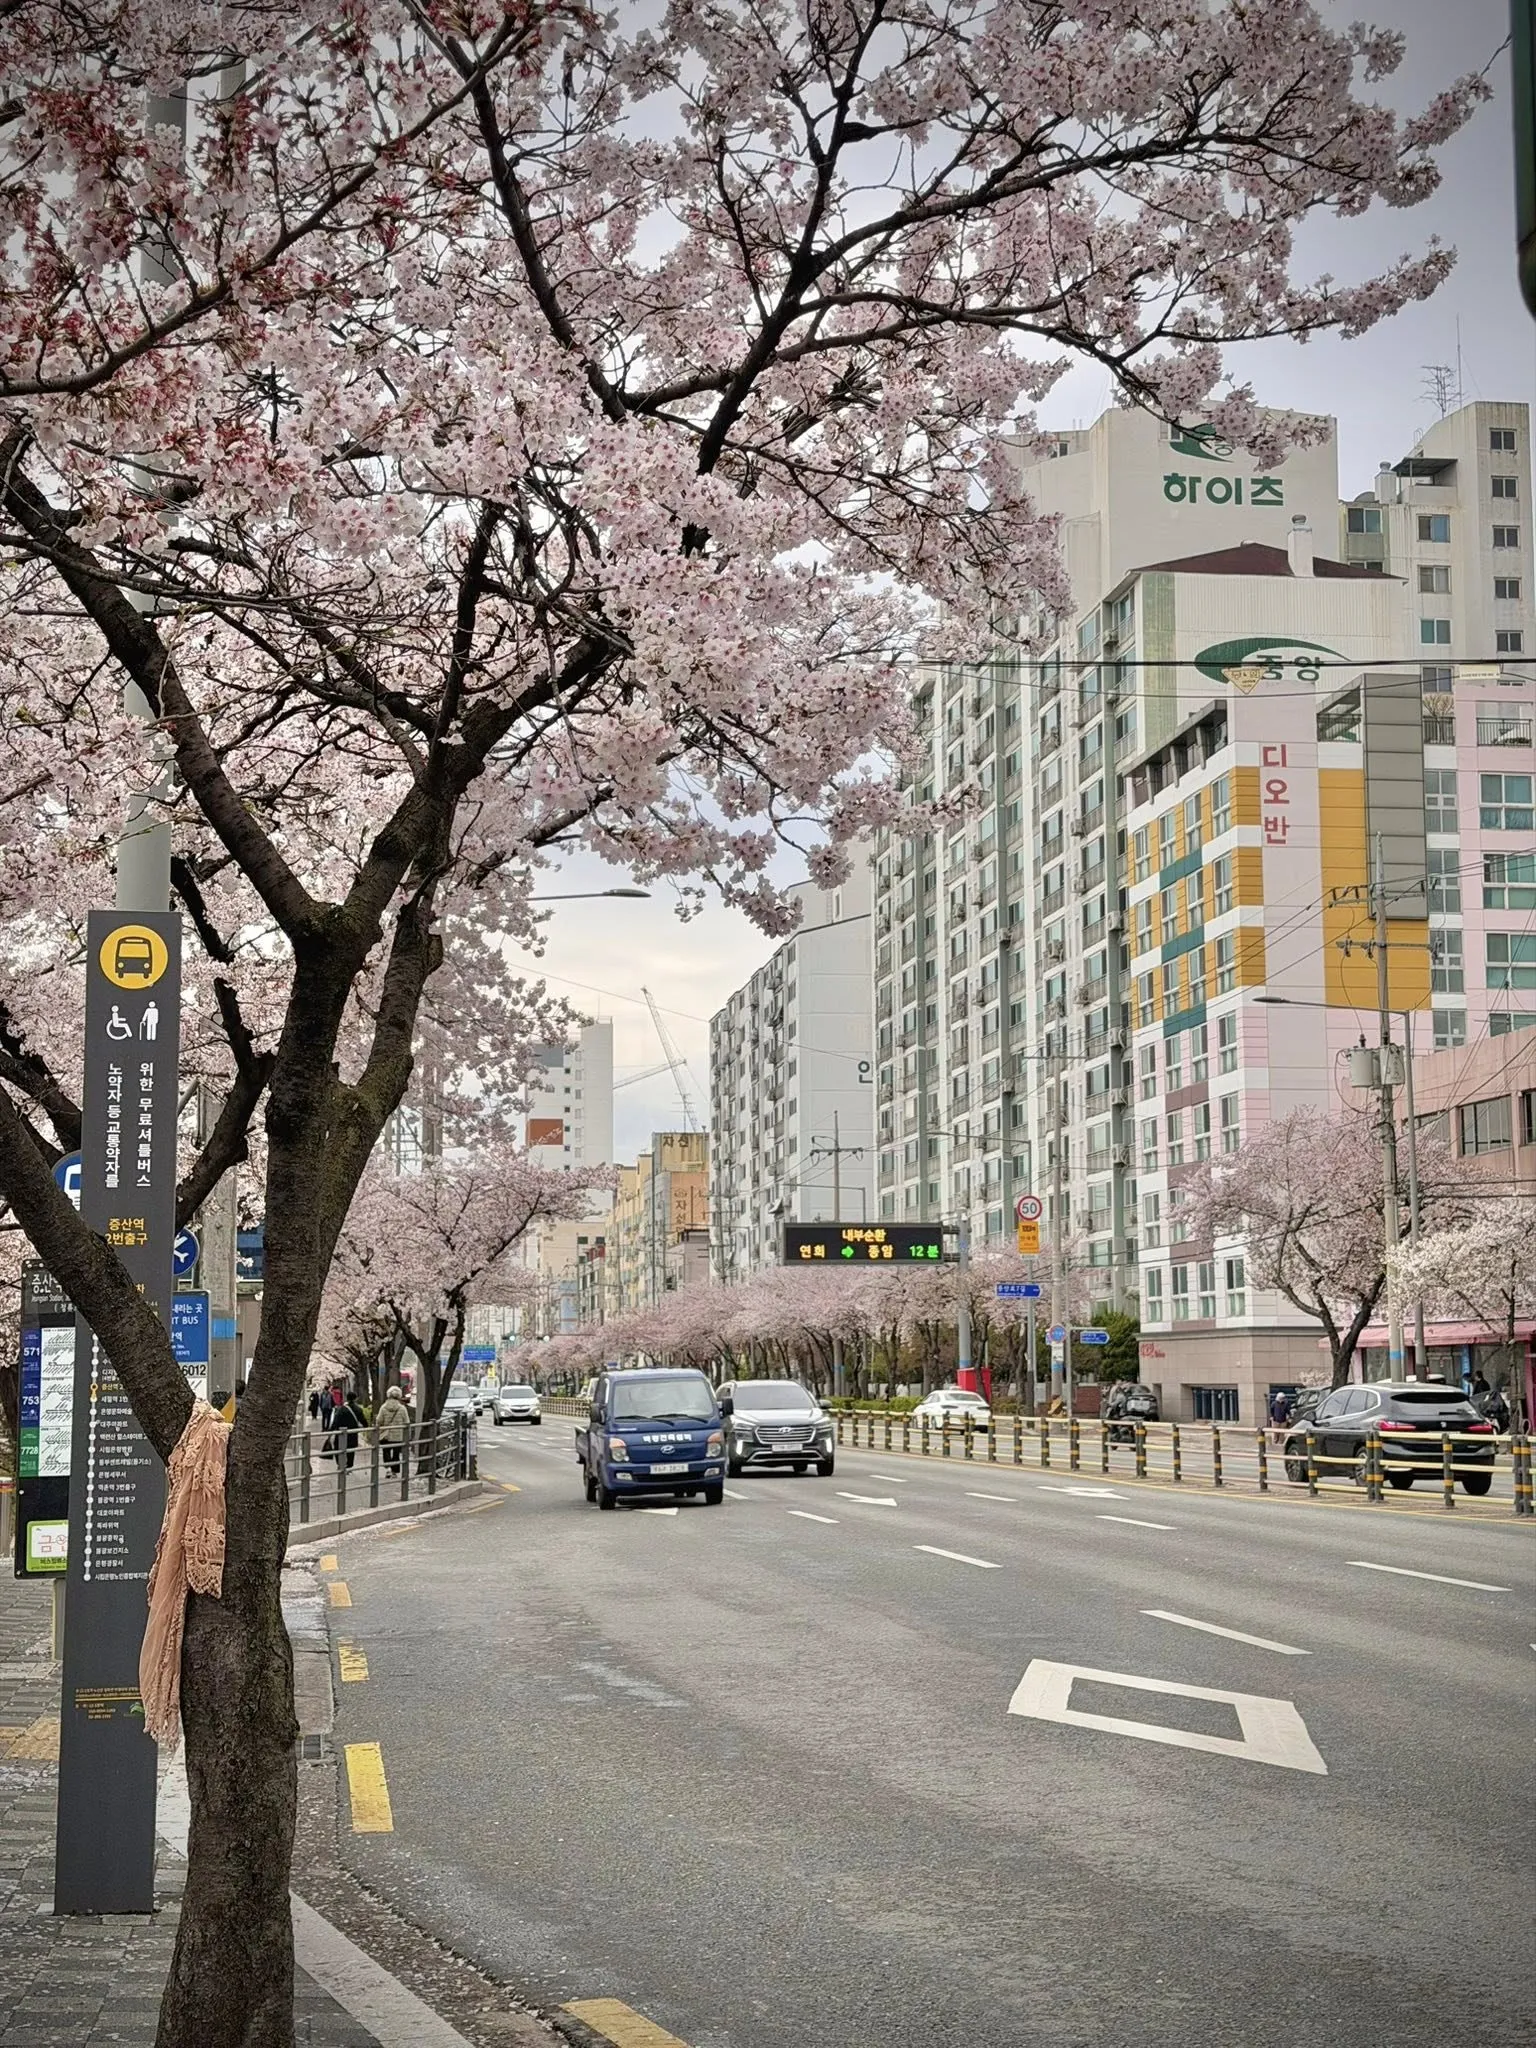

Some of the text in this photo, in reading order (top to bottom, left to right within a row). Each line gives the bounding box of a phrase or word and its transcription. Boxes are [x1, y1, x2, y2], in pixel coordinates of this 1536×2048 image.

[1163, 472, 1285, 506] 하이츠
[1263, 743, 1290, 845] 디오반
[139, 1062, 154, 1092] 위한
[105, 1063, 123, 1188] 노약자 등 교통약자를
[1022, 1202, 1037, 1214] 50
[109, 1218, 144, 1231] 증산역
[105, 1232, 148, 1245] 2번출구
[841, 1228, 887, 1242] 내부순환
[867, 1244, 894, 1259] 종암
[182, 1316, 199, 1325] BUS
[23, 1347, 40, 1356] 571
[182, 1365, 207, 1376] 6012
[22, 1396, 40, 1406] 753
[20, 1446, 39, 1455] 7728
